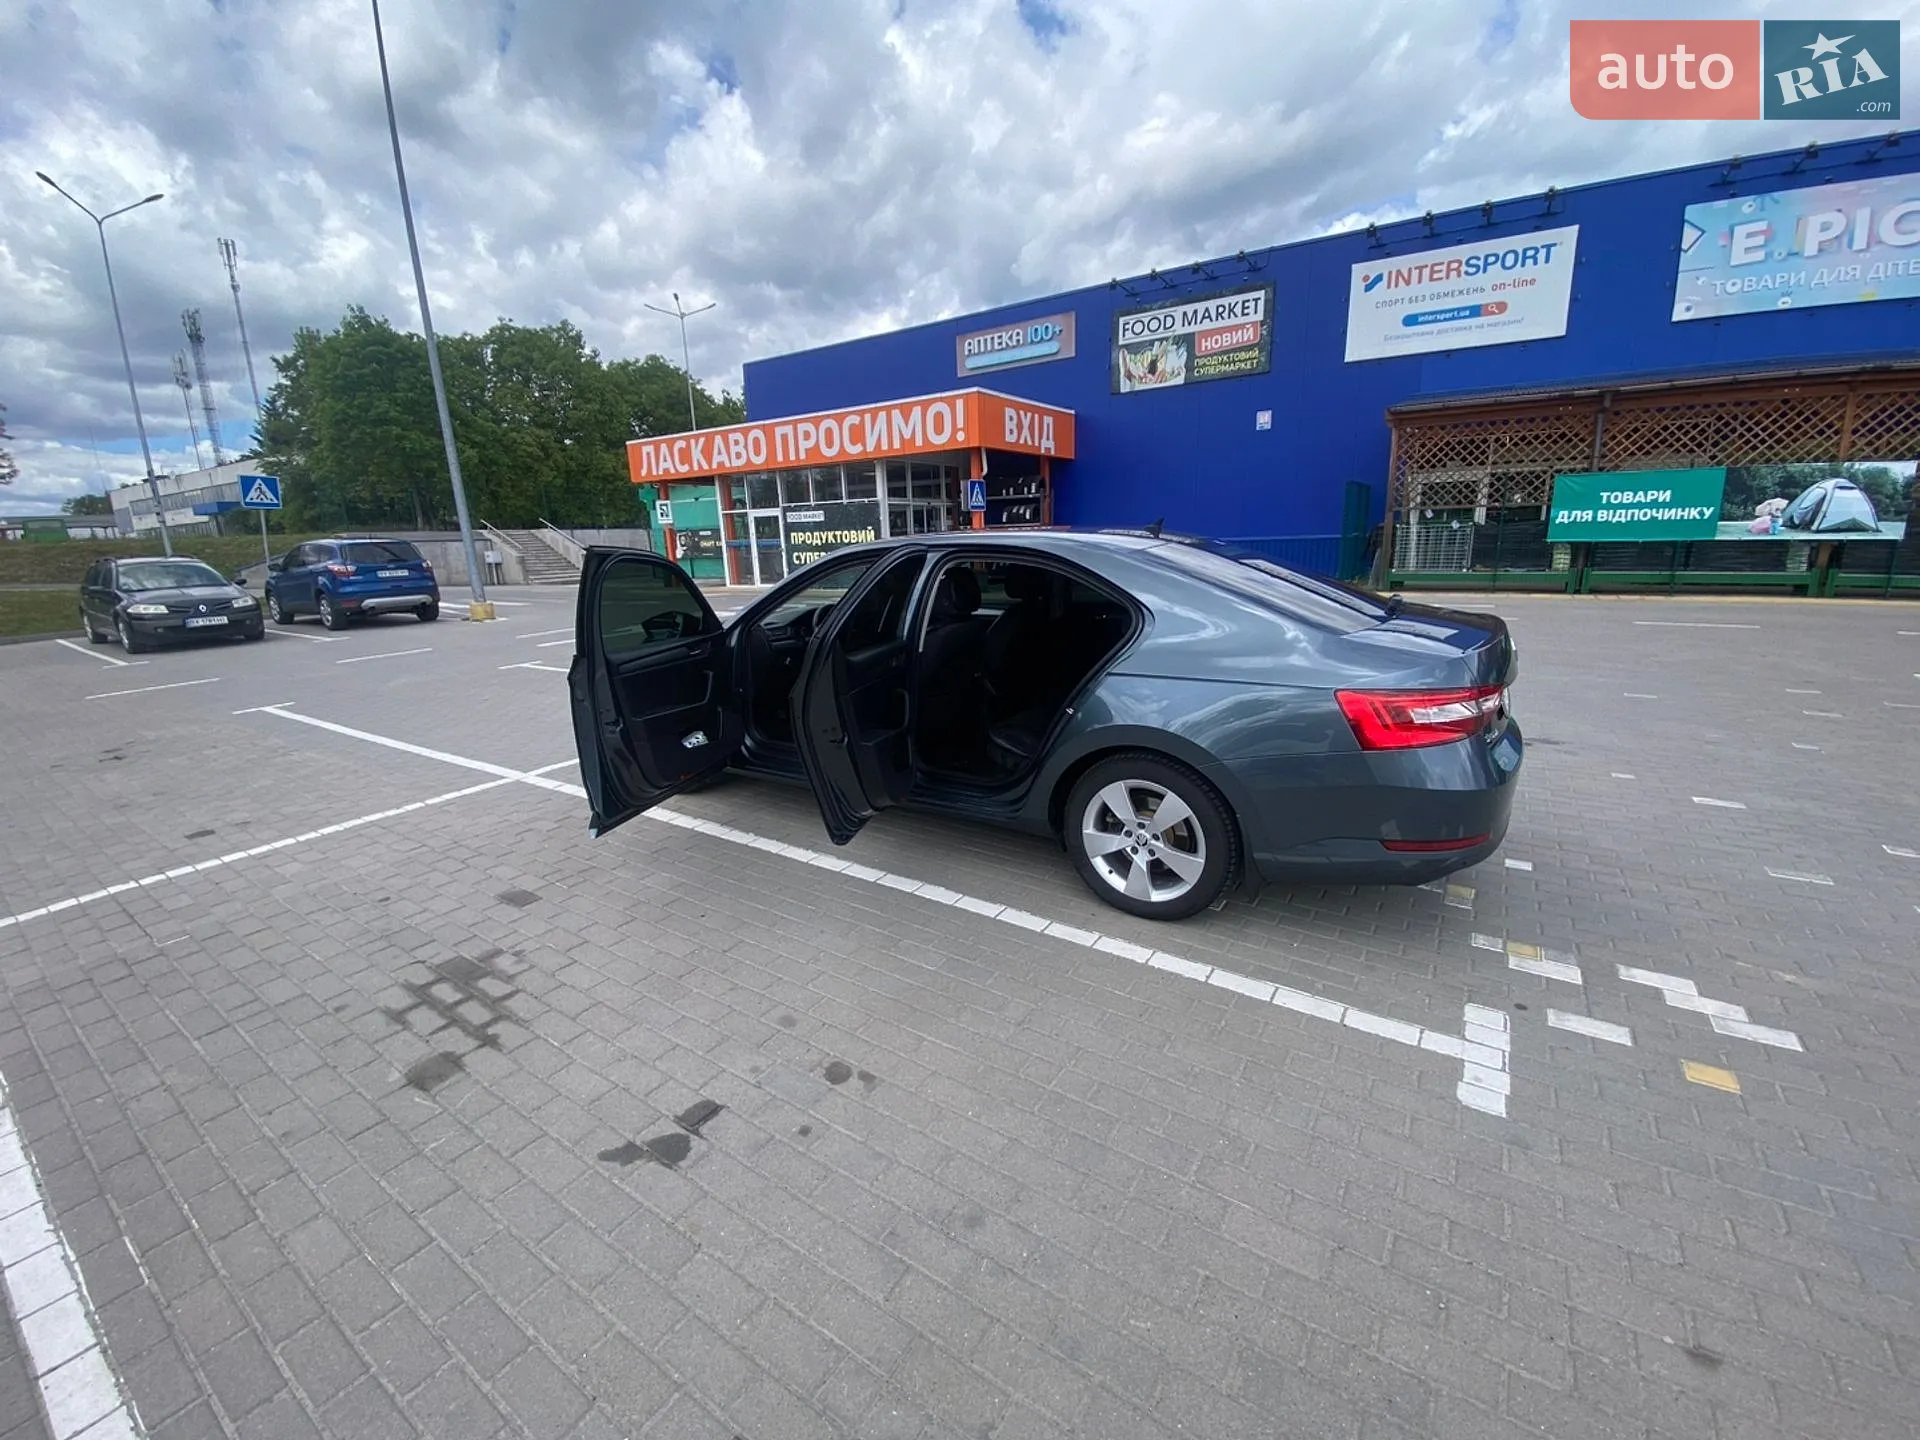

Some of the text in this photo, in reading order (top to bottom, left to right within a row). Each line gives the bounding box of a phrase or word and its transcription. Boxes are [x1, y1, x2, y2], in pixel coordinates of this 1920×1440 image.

[1386, 242, 1557, 290] INTERSPORT
[1711, 271, 1805, 296] ТОВАРИ
[1810, 264, 1861, 288] ДЛЯ
[1375, 277, 1537, 310] СПОРТ БЕЗ ОБМЕЖЕНЬ on-line
[1122, 297, 1262, 338] FOOD MARKET
[964, 323, 1063, 356] АПТЕКА 100+
[1201, 324, 1254, 351] НОВИЙ
[1194, 347, 1259, 367] ПРОДУКТОВИЙ
[1194, 360, 1258, 377] СУПЕРМАРКЕТ
[640, 399, 966, 477] ЛАСКАВО ПРОСИМО!
[1004, 406, 1056, 455] ВХІД
[1600, 490, 1672, 504] ТОВАРИ
[1555, 507, 1715, 523] ДЛЯ ВІДПОЧИНКУ
[790, 526, 875, 546] ПРОДУКТОВИЙ
[793, 551, 831, 565] СУПЕР
